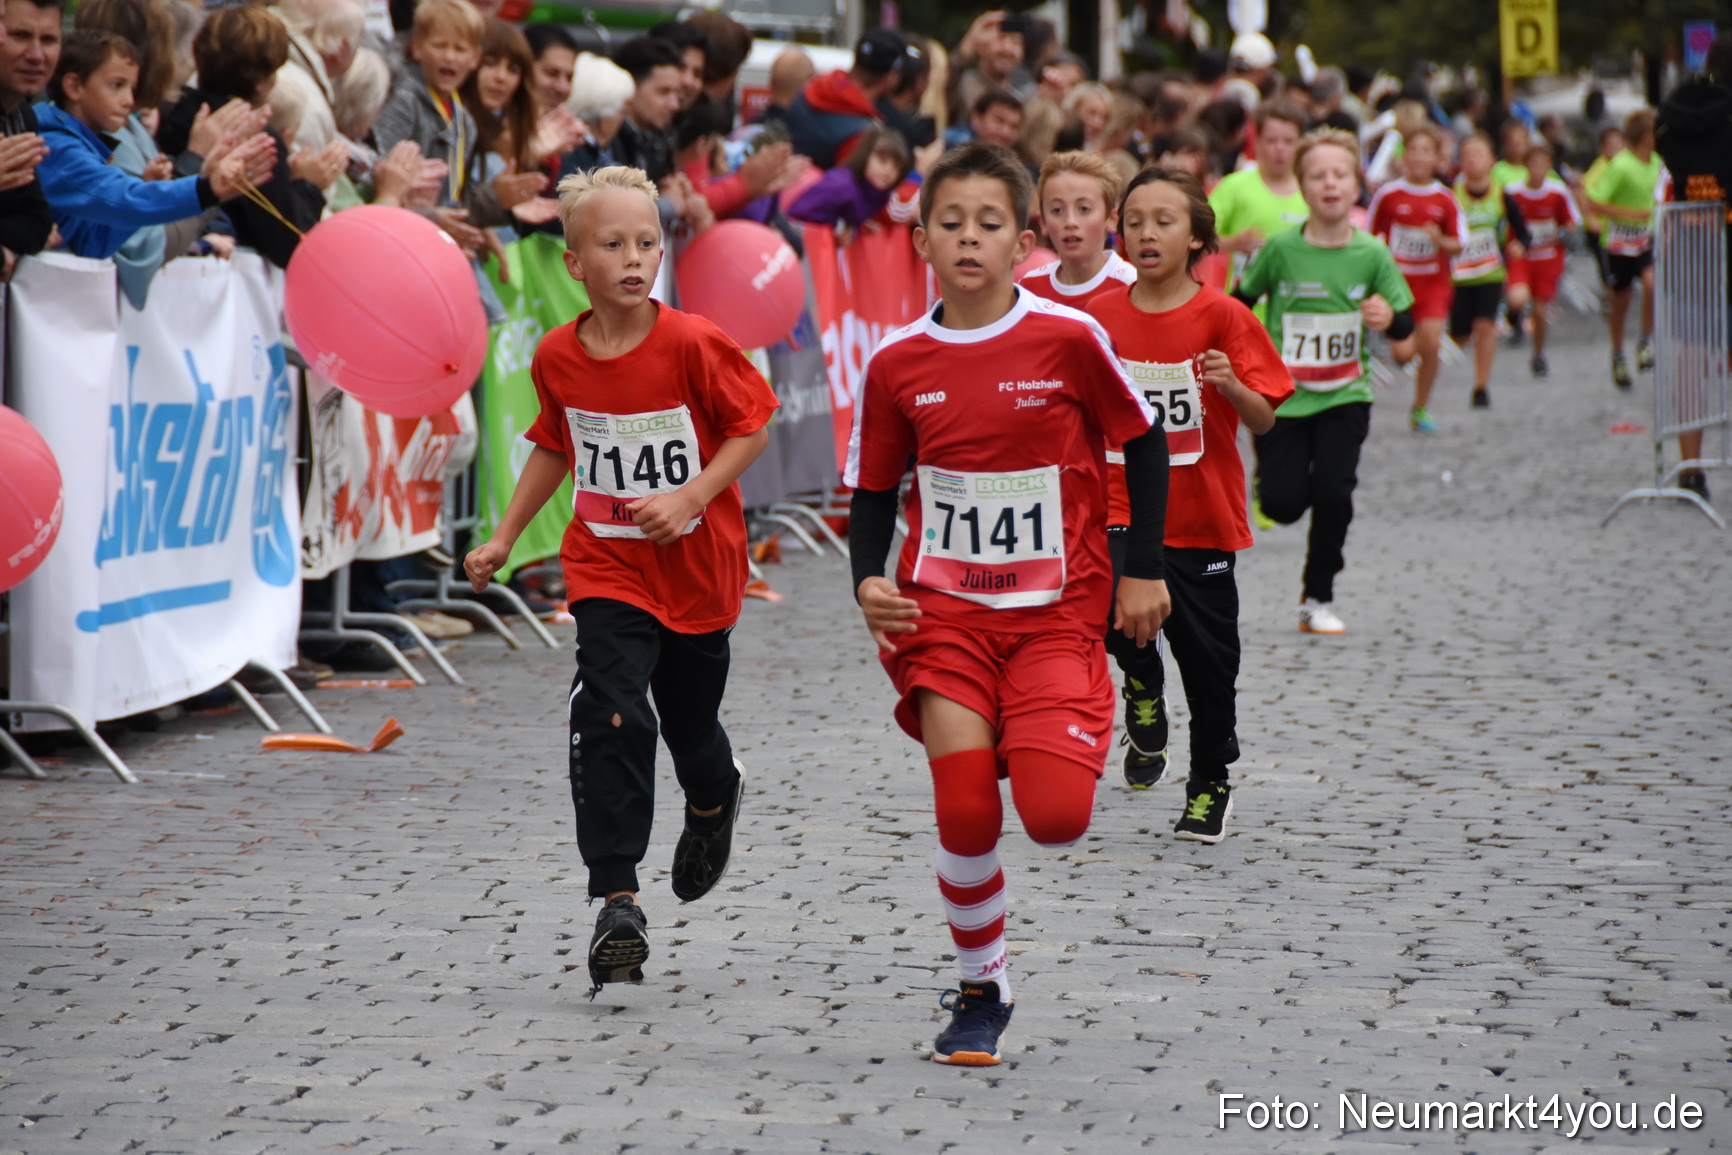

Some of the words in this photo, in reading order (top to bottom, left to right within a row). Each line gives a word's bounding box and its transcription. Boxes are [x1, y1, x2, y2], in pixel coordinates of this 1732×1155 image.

[1515, 16, 1543, 56] D
[1292, 331, 1356, 360] 7169
[1134, 365, 1188, 381] BOCK
[998, 382, 1014, 392] FC
[1017, 379, 1064, 390] Holzheim
[915, 391, 946, 406] JAKO
[1014, 395, 1047, 410] Julian
[616, 413, 685, 434] BOCK
[582, 439, 689, 491] 7146
[975, 473, 1047, 494] BOCK
[934, 501, 1043, 555] 7141
[1207, 561, 1228, 572] JAKO
[960, 568, 1017, 589] Julian
[1078, 731, 1097, 747] JAKO
